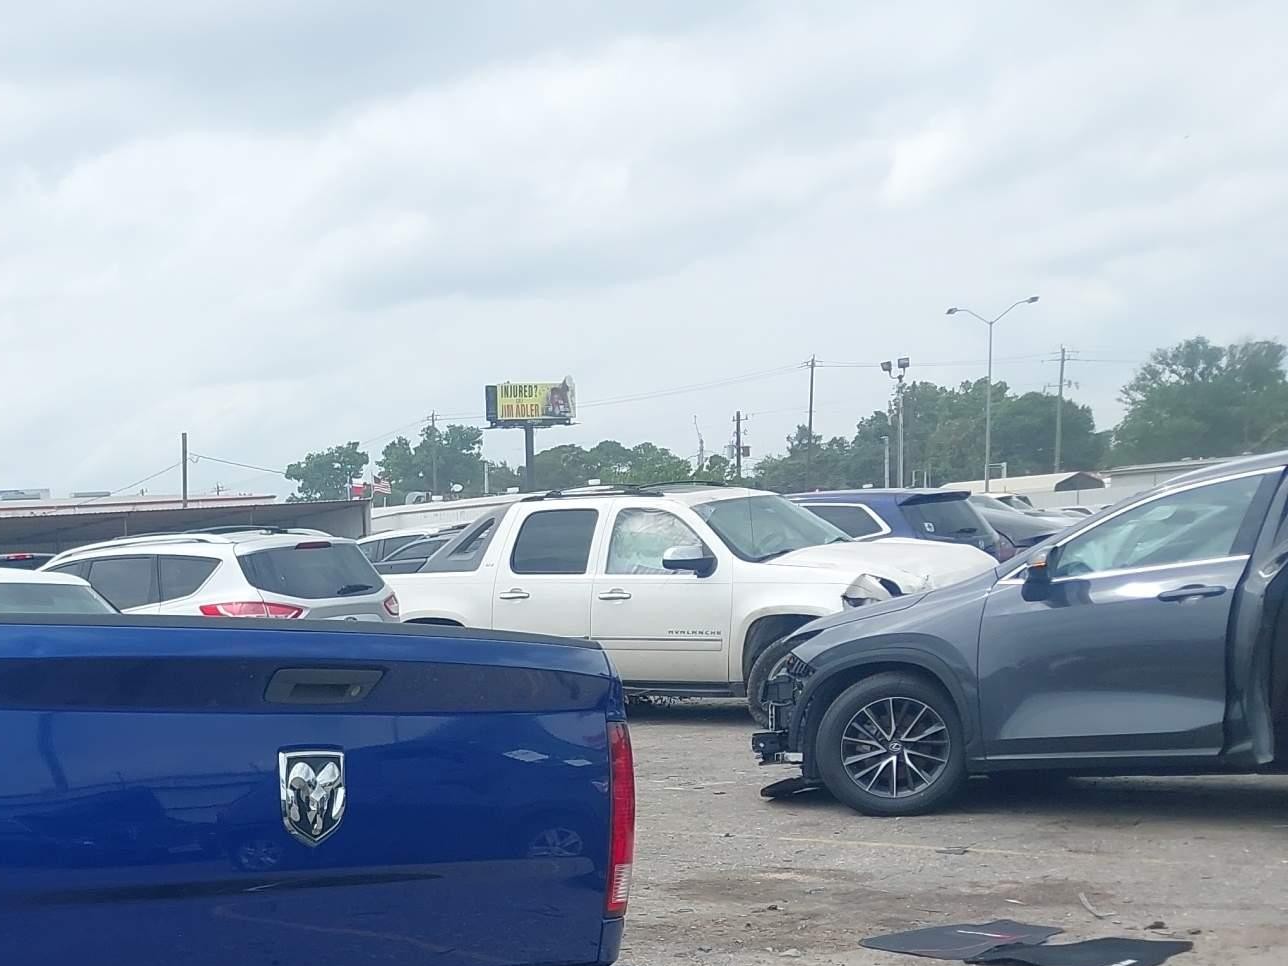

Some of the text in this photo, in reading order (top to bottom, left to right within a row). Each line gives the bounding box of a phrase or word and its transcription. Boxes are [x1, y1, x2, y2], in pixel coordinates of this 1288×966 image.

[500, 384, 538, 399] INJURED?
[500, 403, 540, 418] JIM ADLER
